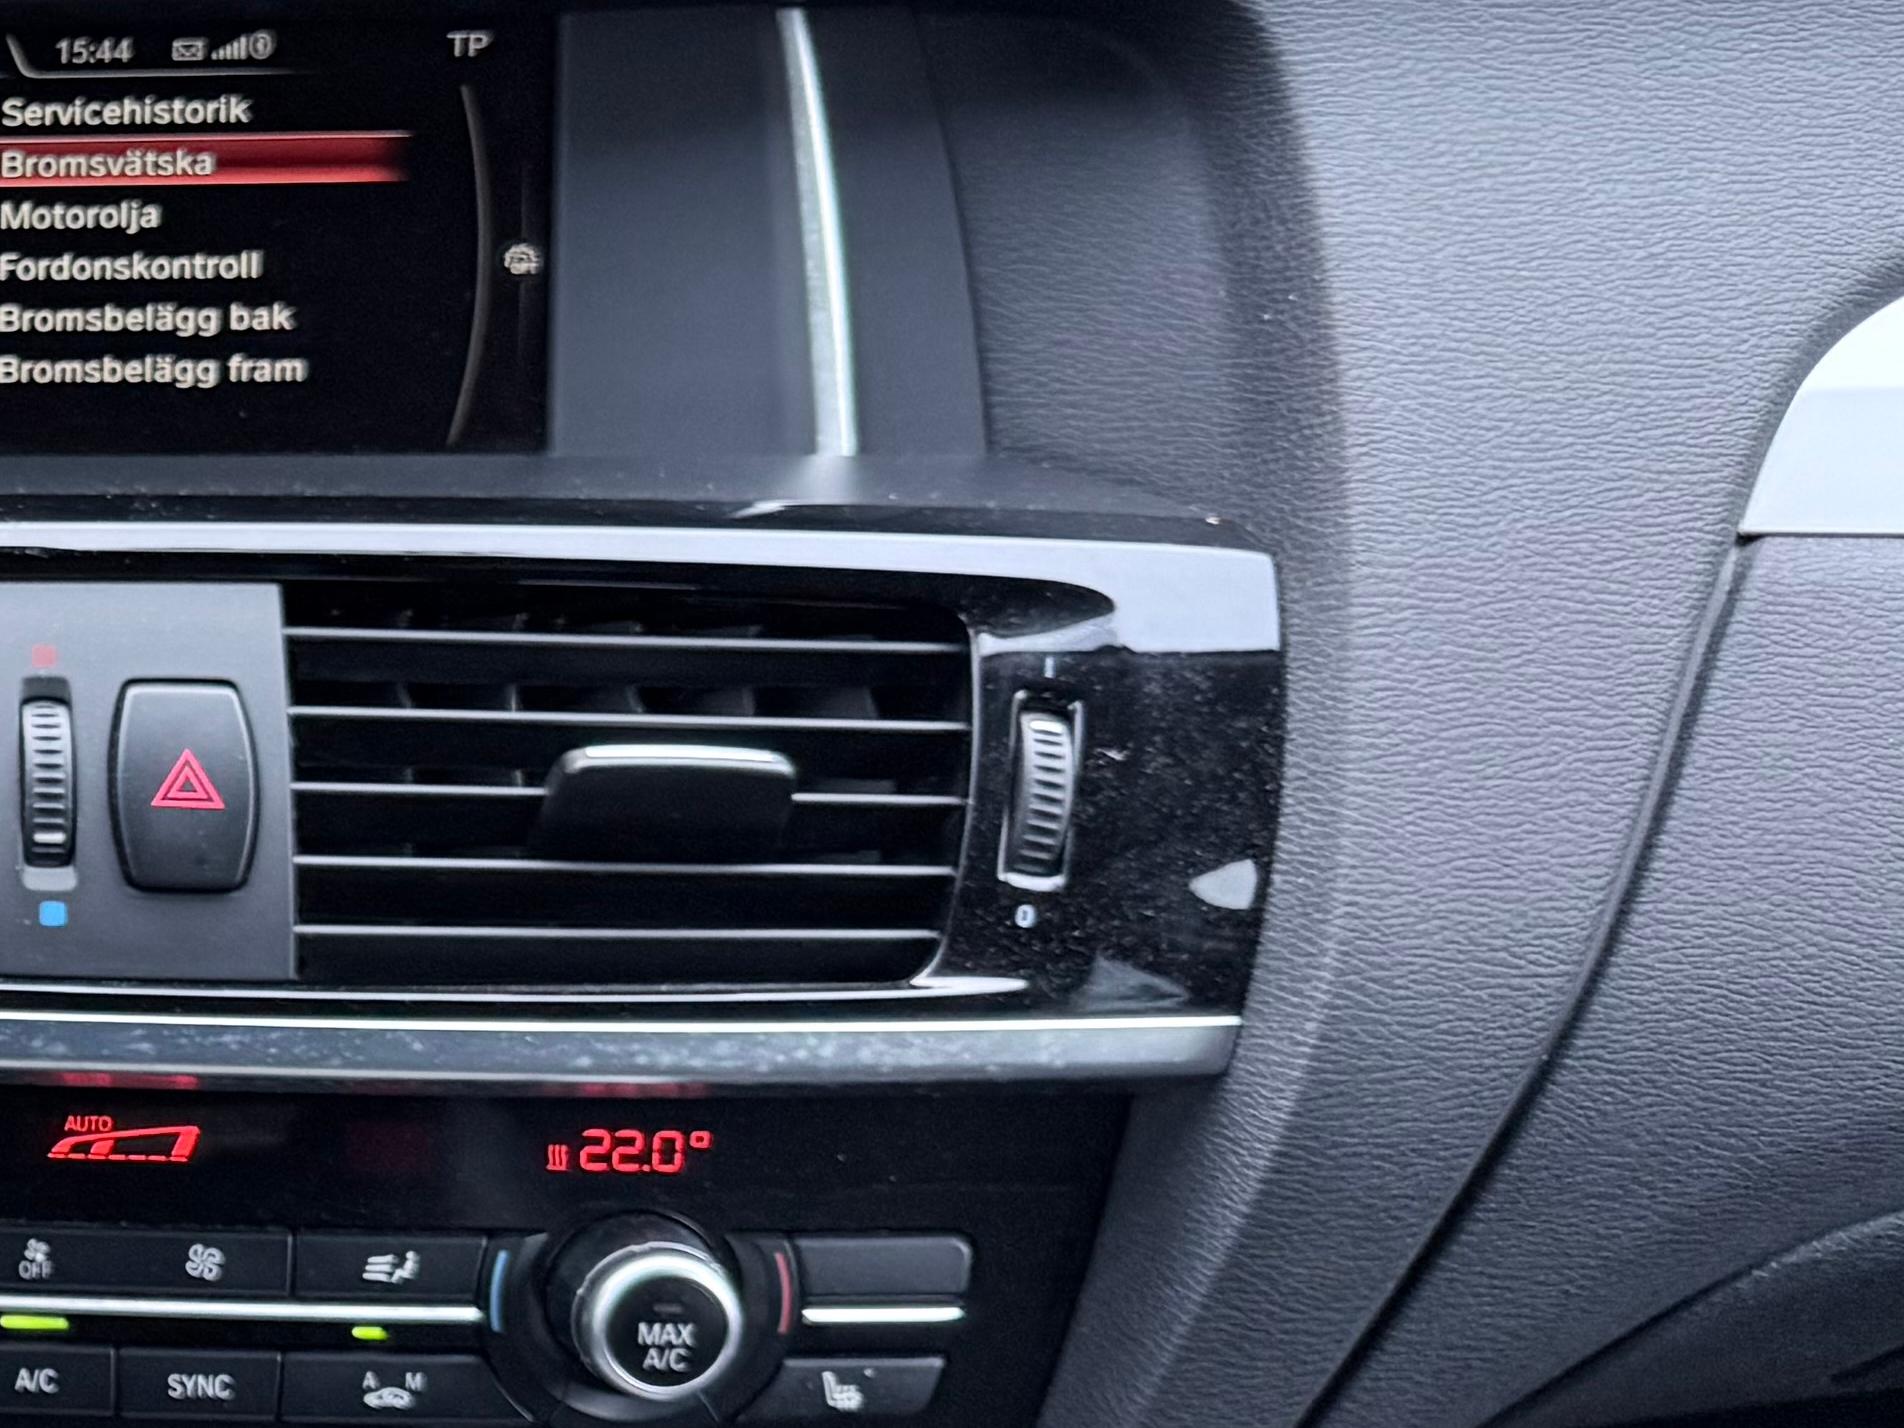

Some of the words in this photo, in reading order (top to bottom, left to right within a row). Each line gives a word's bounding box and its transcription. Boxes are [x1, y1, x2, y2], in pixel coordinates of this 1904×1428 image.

[55, 37, 134, 64] 15:44
[448, 32, 492, 57] TP
[1, 95, 253, 126] Servicehistorik
[1, 148, 216, 178] Bromsvätska
[0, 200, 162, 234] Motorolja
[229, 302, 295, 331] bak
[227, 353, 308, 383] fram
[64, 1114, 113, 1133] AUTO
[18, 1260, 54, 1279] OFF
[638, 1322, 695, 1347] MAX
[642, 1346, 690, 1372] A/C
[15, 1367, 59, 1395] A/C
[167, 1372, 235, 1401] SYNC
